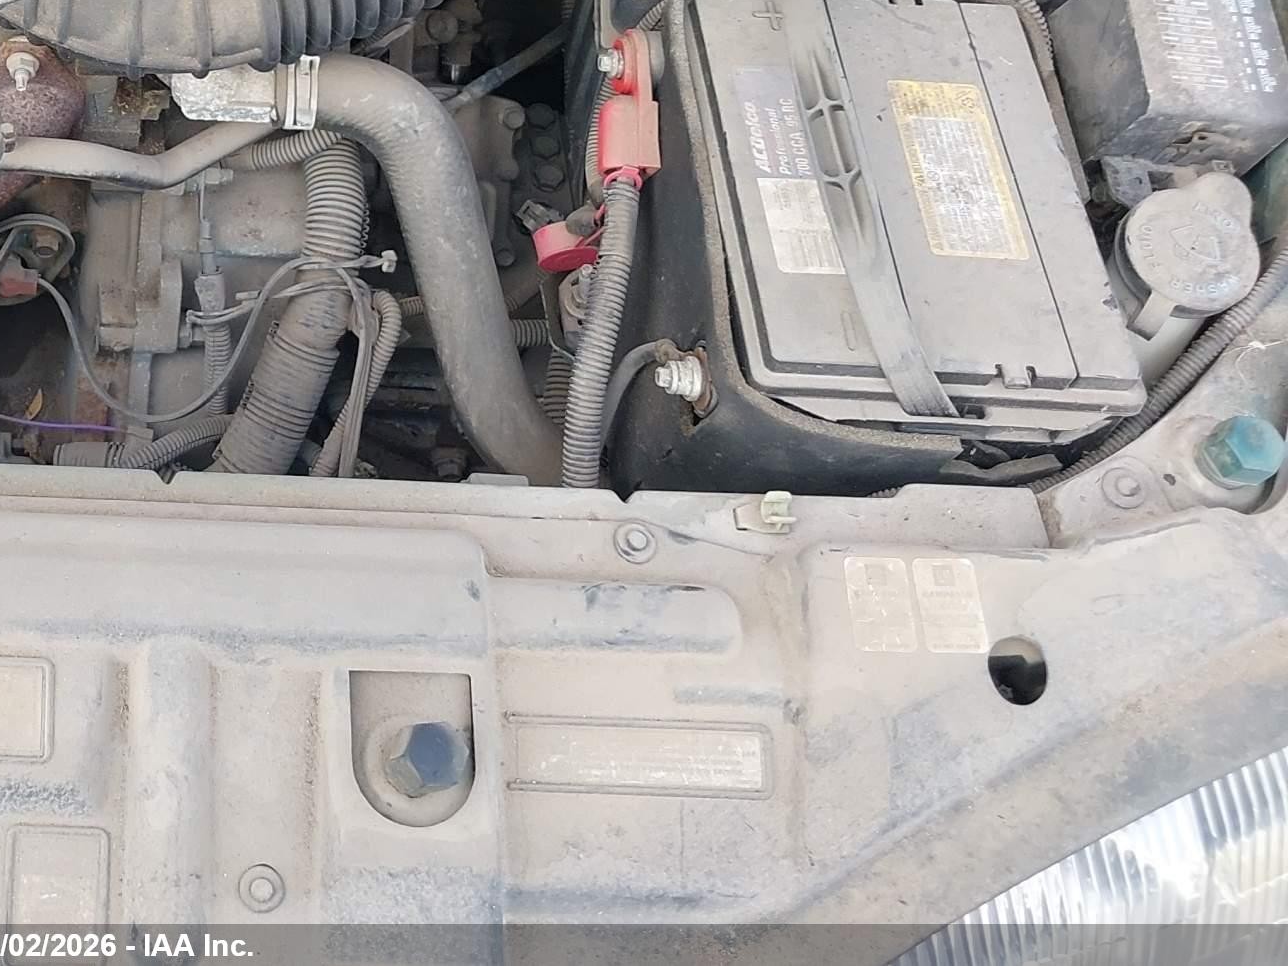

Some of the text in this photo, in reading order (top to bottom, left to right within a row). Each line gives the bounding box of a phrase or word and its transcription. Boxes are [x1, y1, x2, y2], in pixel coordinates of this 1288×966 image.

[790, 130, 806, 155] CCA
[795, 157, 812, 176] 700
[1139, 224, 1162, 269] FLUID
[1169, 273, 1241, 294] WASHER
